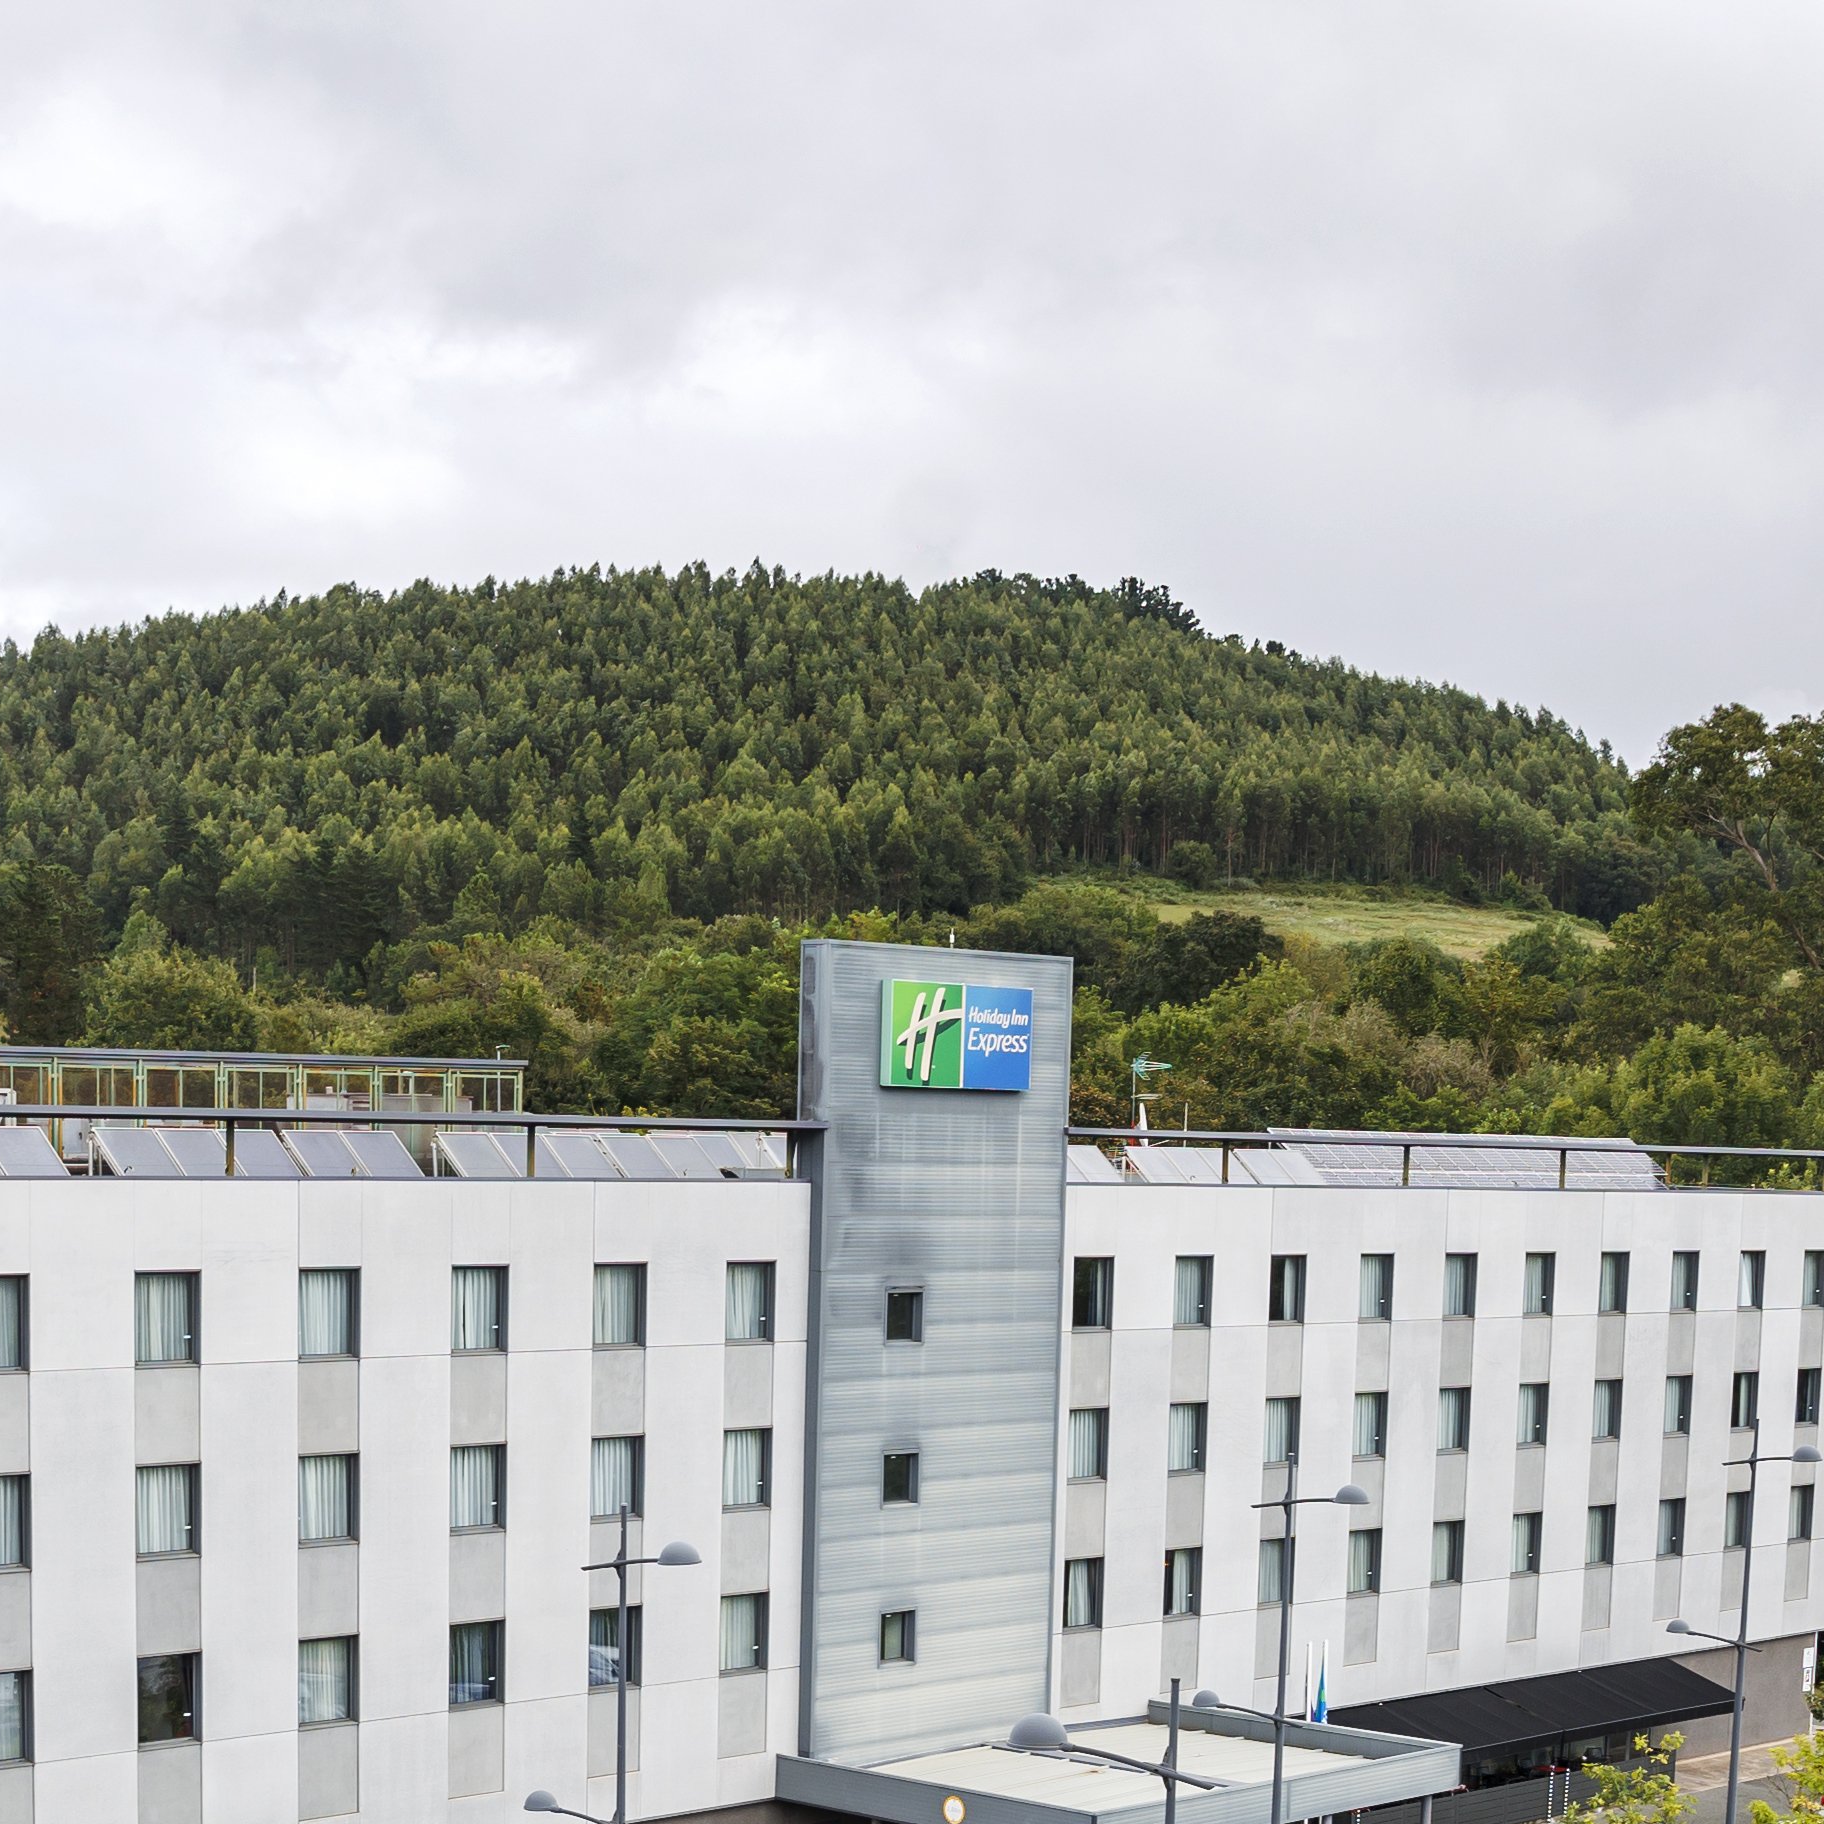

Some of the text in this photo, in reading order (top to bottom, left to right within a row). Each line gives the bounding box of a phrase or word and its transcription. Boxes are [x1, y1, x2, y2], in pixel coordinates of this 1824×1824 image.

[968, 1006, 1029, 1029] Holiday Inn
[967, 1027, 1028, 1057] Express
